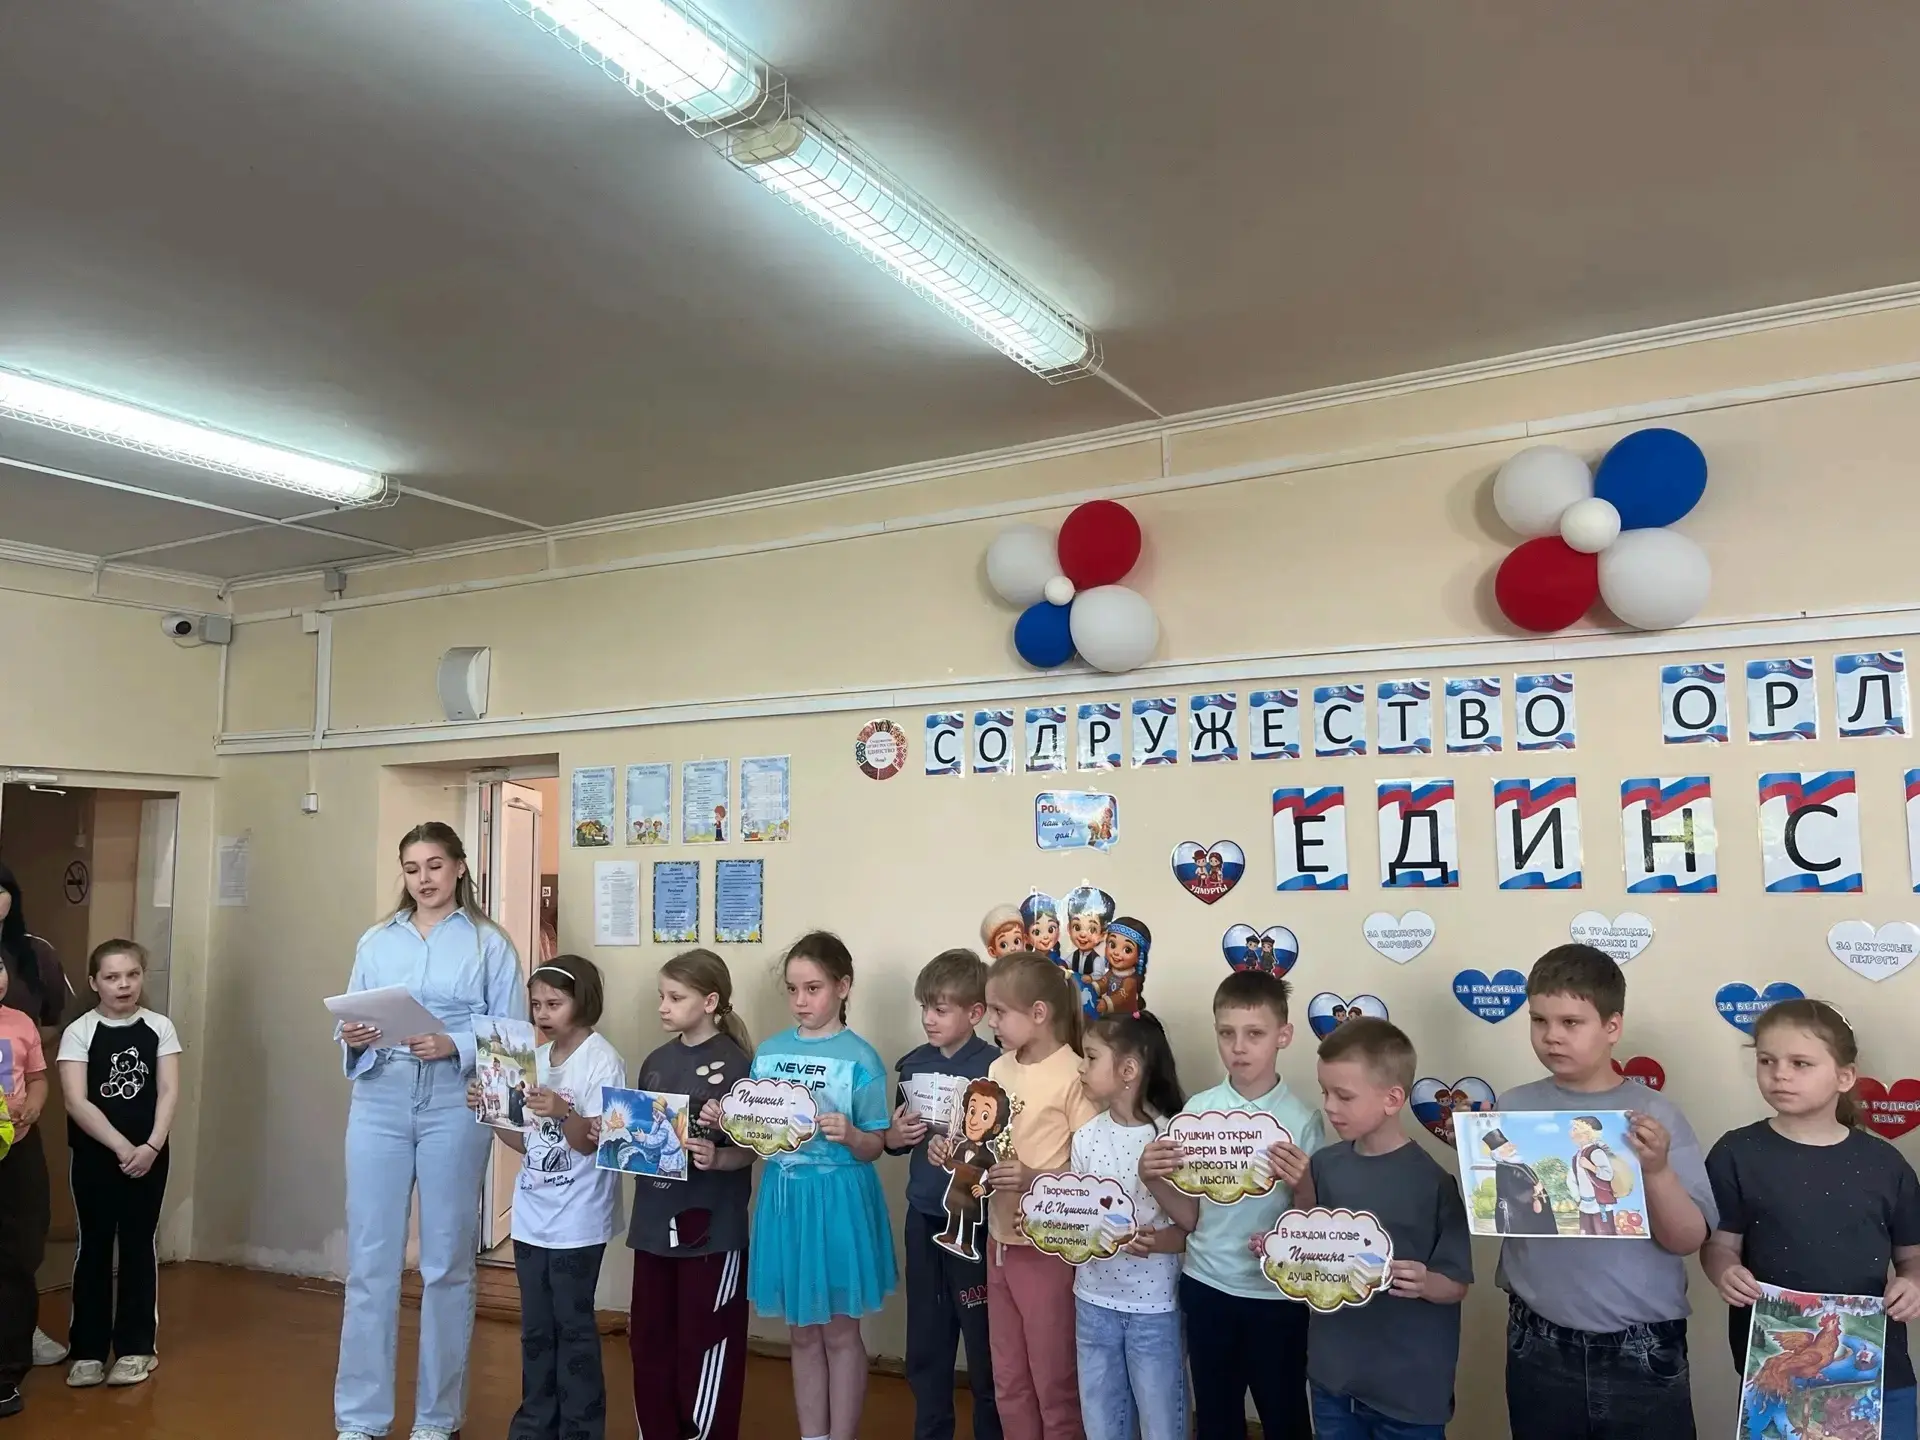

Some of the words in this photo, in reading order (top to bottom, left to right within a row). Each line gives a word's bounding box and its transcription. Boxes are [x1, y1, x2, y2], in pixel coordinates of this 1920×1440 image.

[933, 694, 1566, 769] СОДРУЖЕСТВО
[1672, 674, 1893, 730] ОРЛ
[1054, 829, 1075, 841] дом!
[1294, 804, 1842, 885] ЕДИНС
[1190, 884, 1229, 895] УДМУРТЫ
[1366, 930, 1379, 938] ЗА
[1572, 926, 1586, 935] ЗА
[1585, 938, 1628, 948] СКАЗКИ
[1630, 940, 1638, 948] И
[1836, 941, 1851, 950] ЗА
[1854, 942, 1913, 953] ВКУСНЫЕ
[1850, 954, 1899, 965] ПИРОГИ
[1456, 985, 1469, 994] ЗА
[1472, 984, 1526, 994] КРАСИВЫЕ
[1473, 996, 1500, 1005] ЛЕСА
[1502, 996, 1511, 1005] И
[1480, 1008, 1505, 1016] РЕКИ
[1718, 1002, 1734, 1012] ЗА
[774, 1061, 827, 1076] NEVER
[738, 1089, 785, 1107] Пушкин
[733, 1113, 754, 1123] гений
[755, 1114, 789, 1128] русской
[1873, 1114, 1906, 1123] ЯЗЫК
[746, 1131, 773, 1141] поэзии
[1174, 1129, 1215, 1143] Пушкин
[1218, 1130, 1262, 1142] открыл
[1220, 1146, 1227, 1155] в
[1231, 1146, 1254, 1158] мир
[1189, 1162, 1237, 1172] красоты
[1240, 1162, 1248, 1170] и
[1200, 1175, 1239, 1185] мысли.
[1043, 1185, 1090, 1197] Творчество
[1042, 1220, 1089, 1231] объединяет
[1281, 1228, 1288, 1238] В
[1291, 1230, 1326, 1241] каждом
[1329, 1230, 1360, 1240] слове
[1289, 1245, 1345, 1264] Пушкина
[1287, 1271, 1312, 1283] душа
